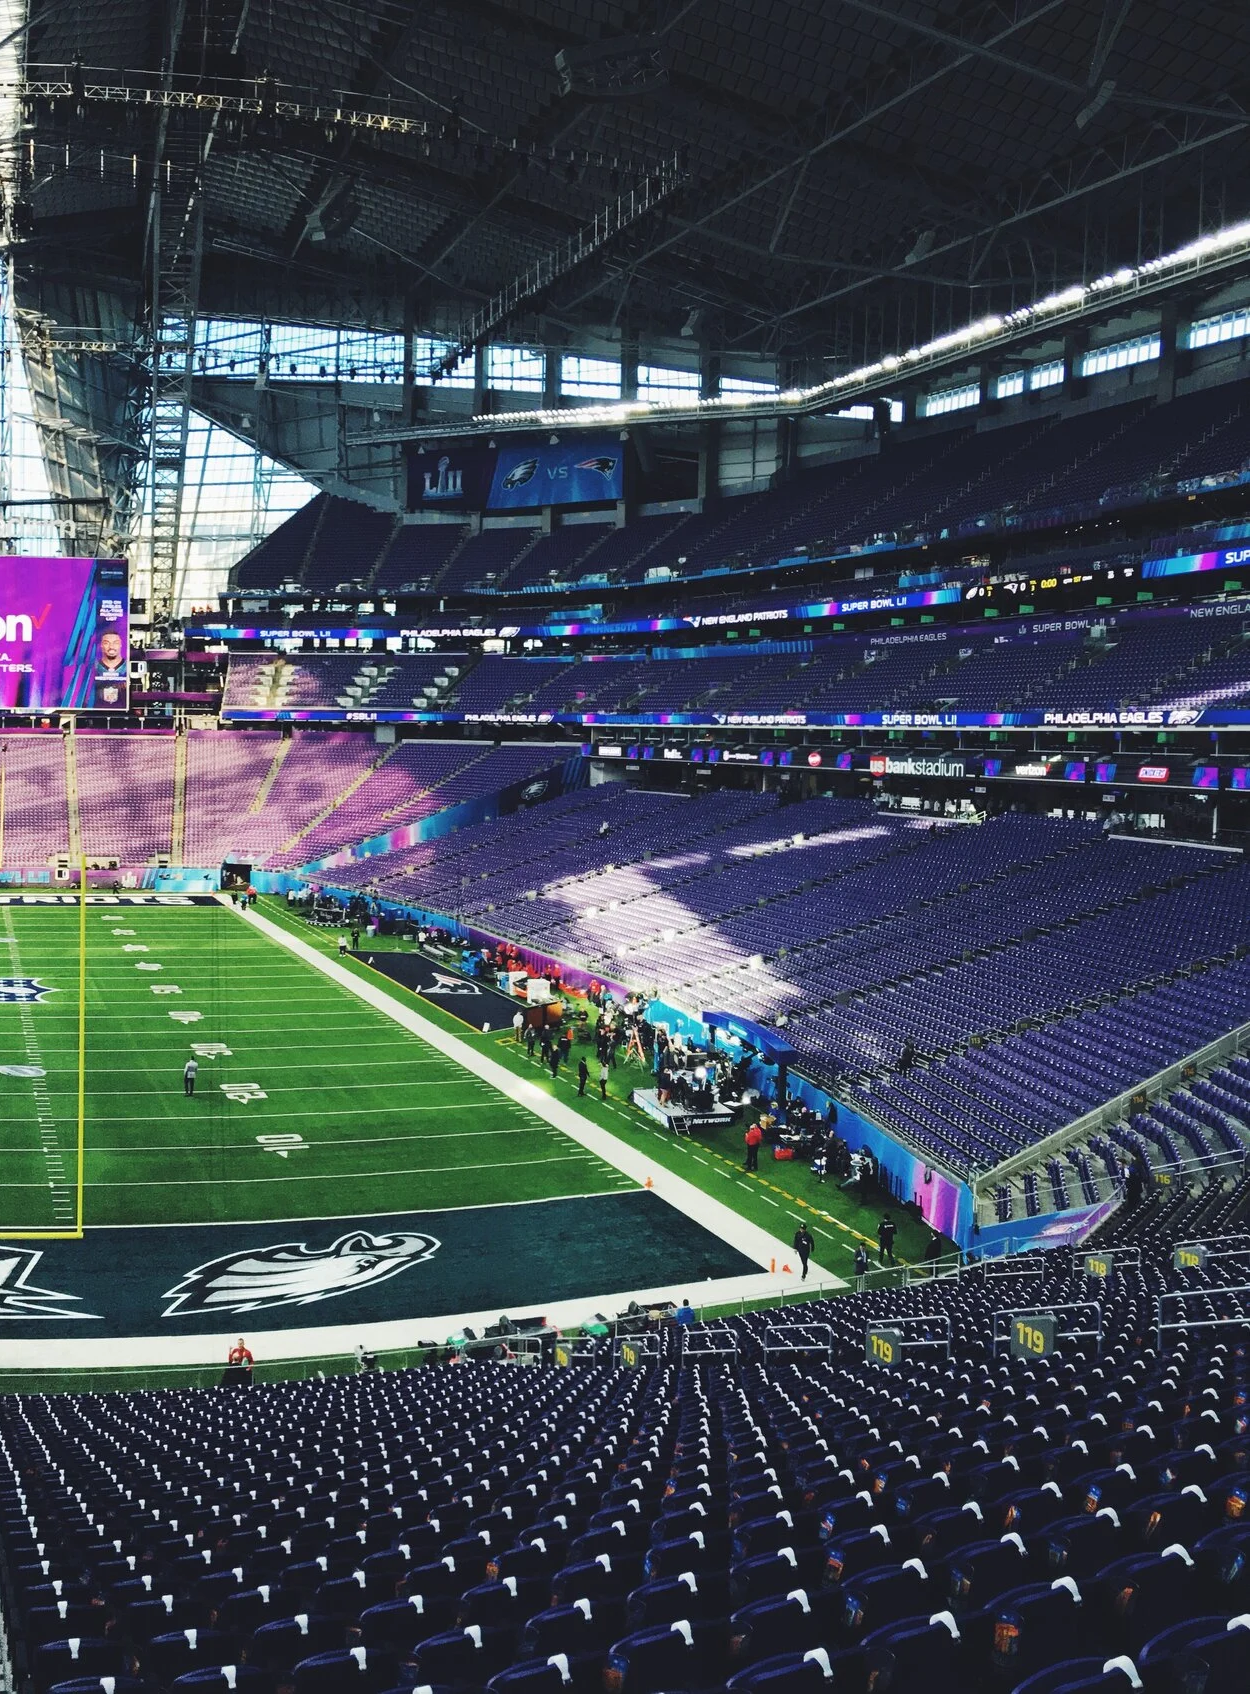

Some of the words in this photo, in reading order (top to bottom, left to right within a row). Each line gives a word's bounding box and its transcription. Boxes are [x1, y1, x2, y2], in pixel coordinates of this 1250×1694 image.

[547, 467, 568, 480] VS
[841, 602, 868, 612] SUPER
[871, 599, 894, 609] BOWL
[897, 597, 907, 606] LII
[701, 616, 718, 626] NEW
[719, 613, 753, 624] ENGLAND
[753, 610, 788, 621] PATRIOTS
[1190, 606, 1215, 619] NEW
[400, 629, 461, 637] PHILADELPHIA
[462, 628, 496, 637] EAGLES
[1032, 622, 1062, 633] SUPER
[1065, 620, 1091, 631] BOWL
[260, 630, 290, 638] SUPER
[292, 630, 318, 638] BOWL
[320, 630, 331, 638] LII
[870, 634, 918, 646] PHILADELPHIA
[919, 632, 947, 643] EAGLES
[464, 714, 511, 722] PHILADELPHIA
[727, 715, 742, 724] NEW
[742, 715, 773, 724] ENGLAND
[774, 715, 806, 724] PATRIOTS
[881, 714, 912, 725] SUPER
[914, 714, 942, 725] BOWL
[945, 714, 957, 725] LII
[1044, 713, 1117, 724] PHILADELPHIA
[1119, 712, 1164, 724] EAGLES
[1015, 763, 1047, 777] verizon
[1088, 1257, 1107, 1276] 118
[1016, 1322, 1045, 1354] 119
[871, 1335, 892, 1363] 119
